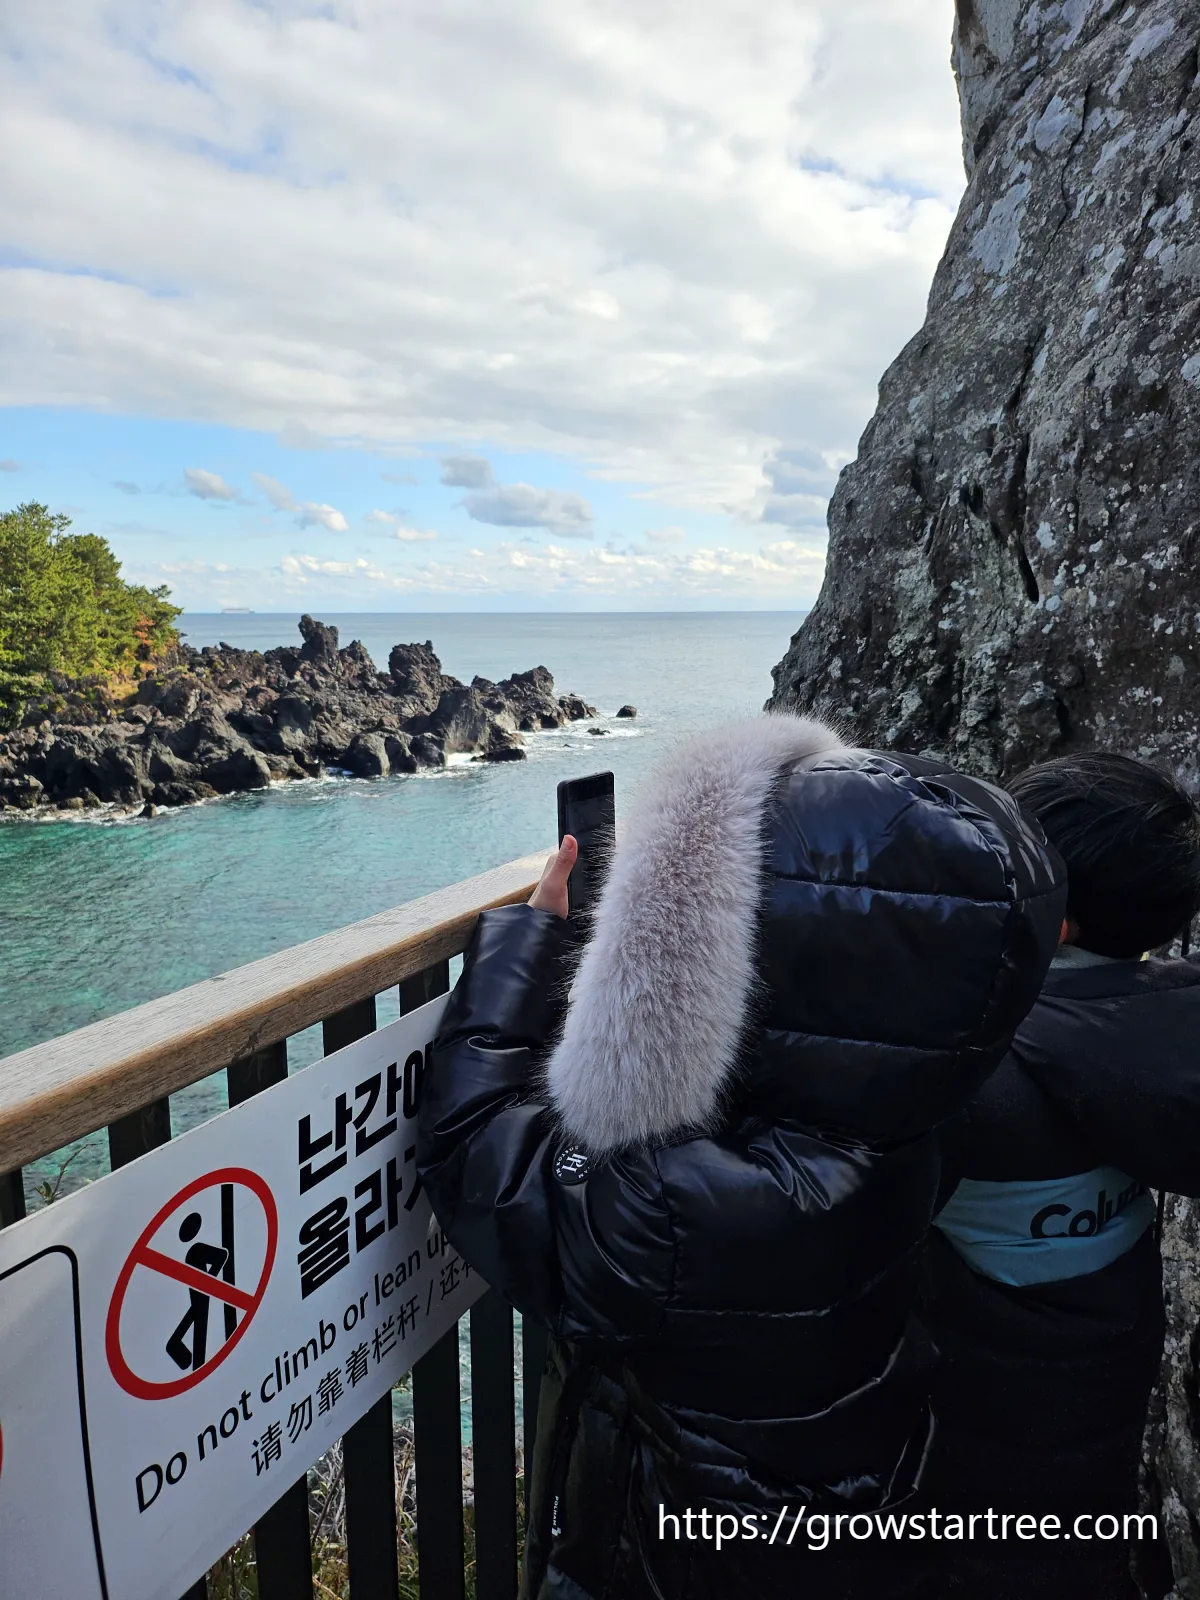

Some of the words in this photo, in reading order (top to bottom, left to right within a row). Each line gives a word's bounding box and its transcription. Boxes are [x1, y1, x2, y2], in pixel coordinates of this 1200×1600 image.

[135, 1451, 188, 1514] Do
[197, 1389, 253, 1461] not
[260, 1319, 336, 1403] climb
[343, 1292, 368, 1331] or
[374, 1249, 421, 1306] lean
[251, 1294, 420, 1476] 请勿靠着栏杆
